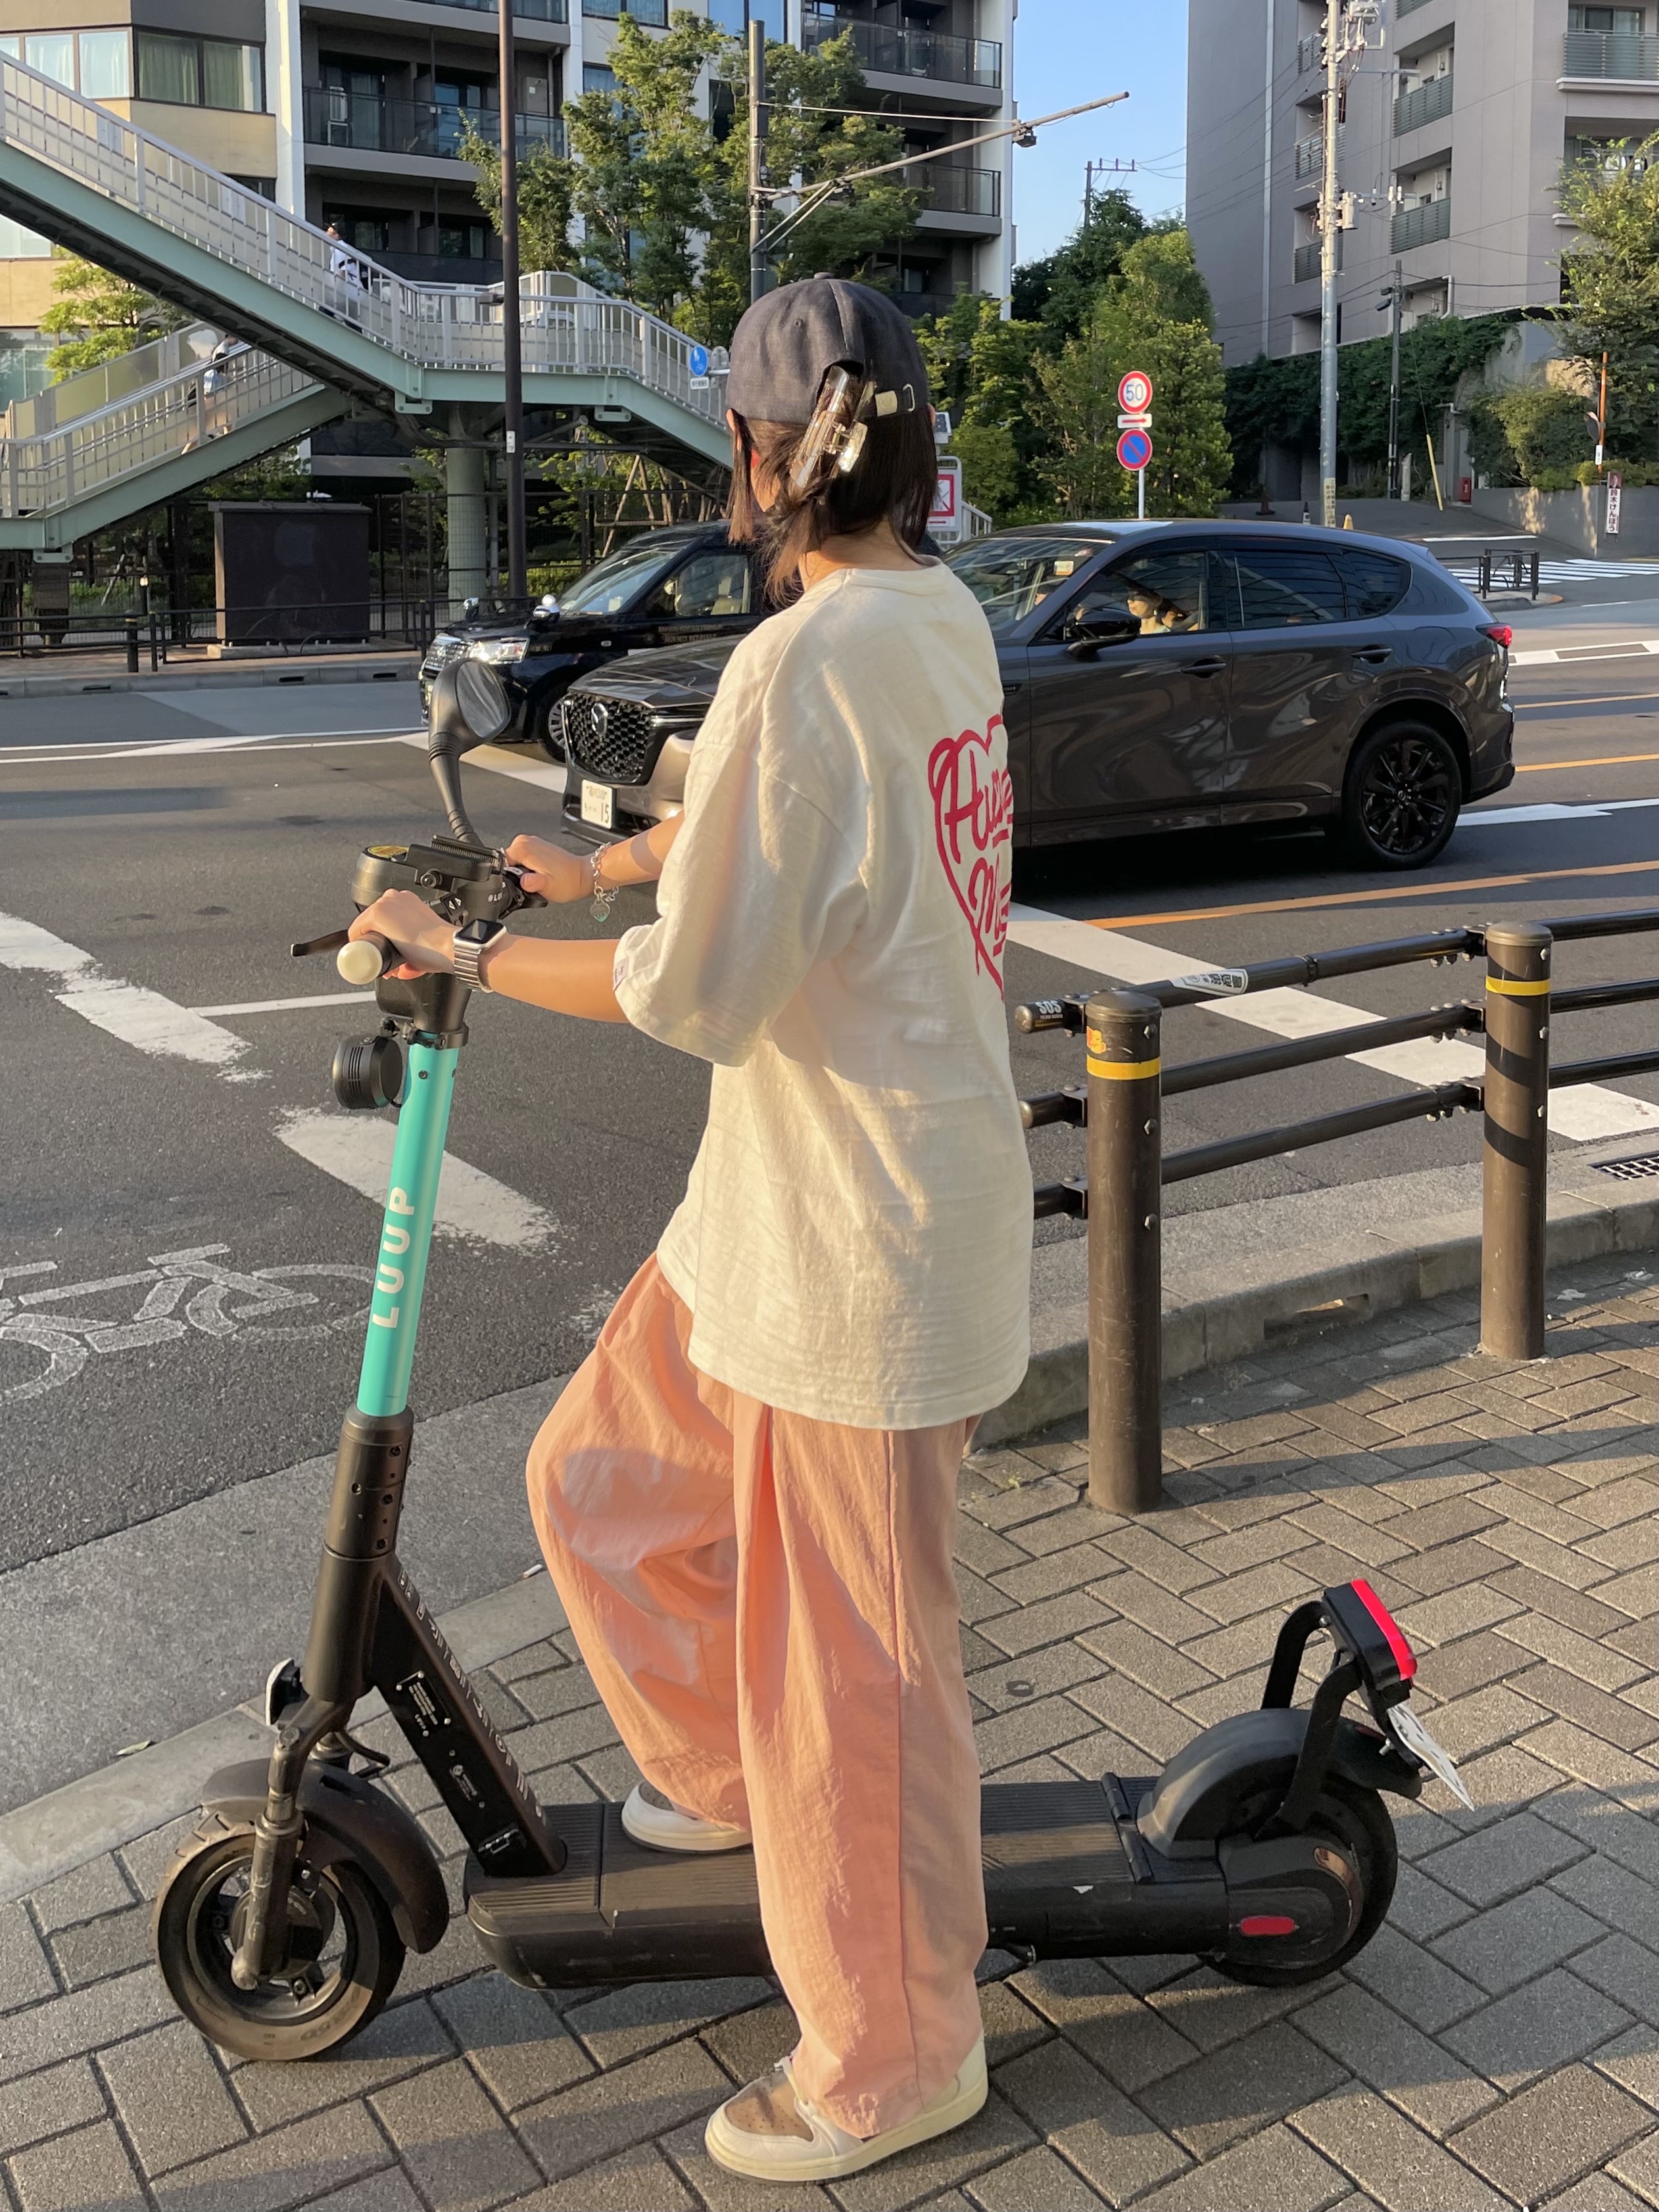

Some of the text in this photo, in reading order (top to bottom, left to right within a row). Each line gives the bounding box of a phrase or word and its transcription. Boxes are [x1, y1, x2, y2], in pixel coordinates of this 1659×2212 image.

[1126, 383, 1143, 401] 50
[1035, 1000, 1062, 1014] SOS
[372, 1187, 414, 1329] LUUP
